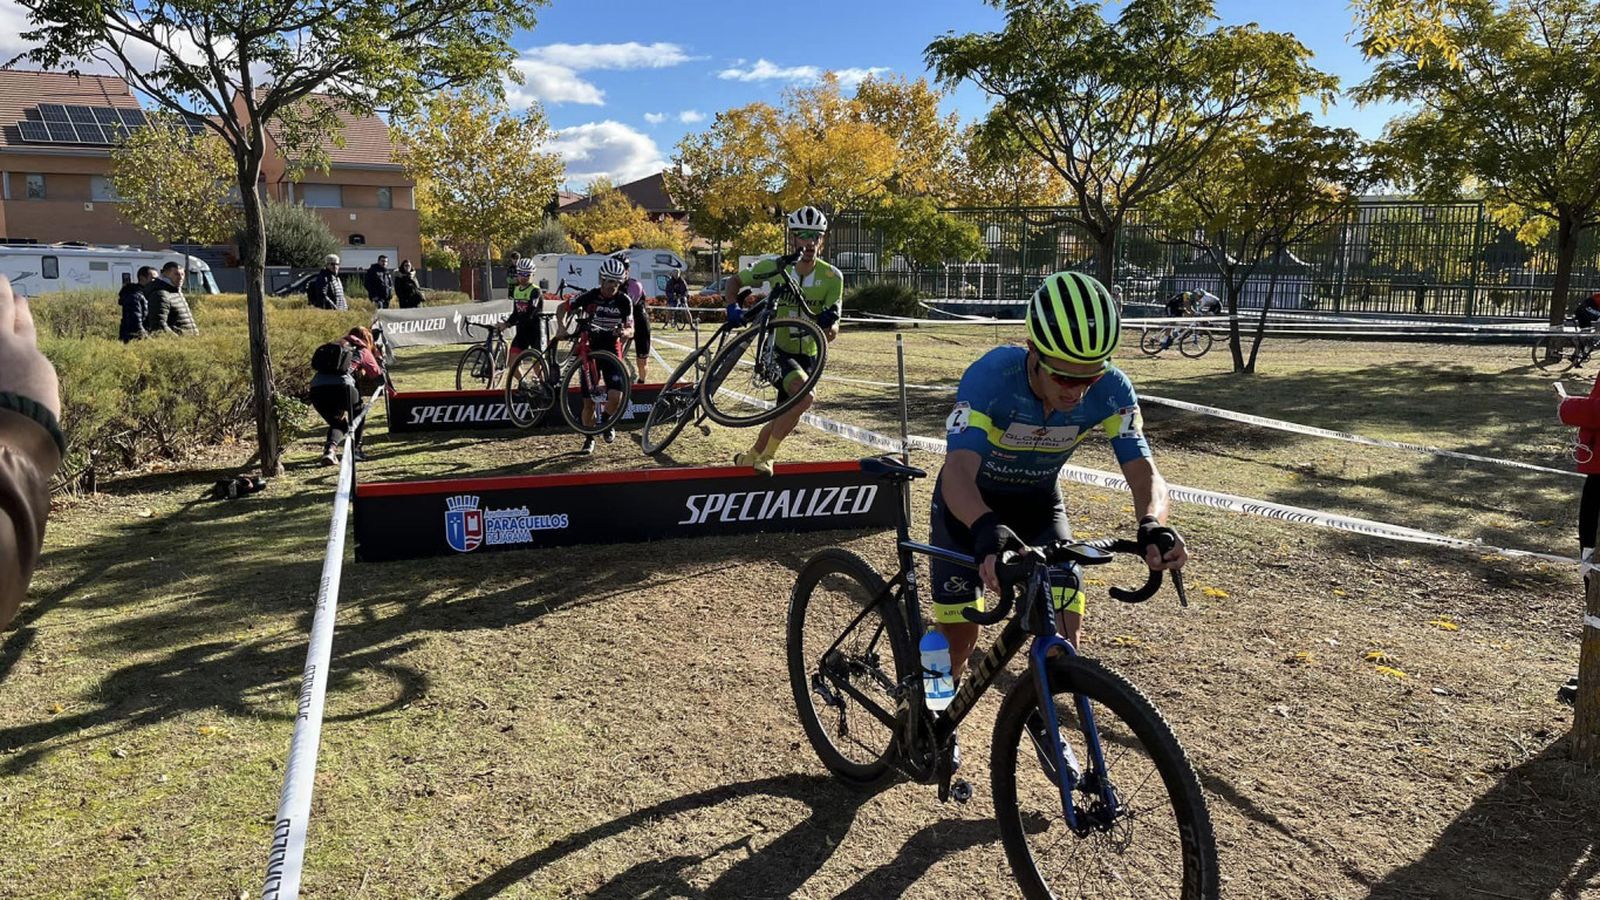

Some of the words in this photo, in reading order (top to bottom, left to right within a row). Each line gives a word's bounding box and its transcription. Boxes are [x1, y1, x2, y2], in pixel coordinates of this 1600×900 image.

[387, 317, 447, 335] SPECIALIZED
[952, 409, 963, 427] 2
[677, 484, 879, 525] SPECIALIZED
[486, 515, 568, 533] PARACUELLOS
